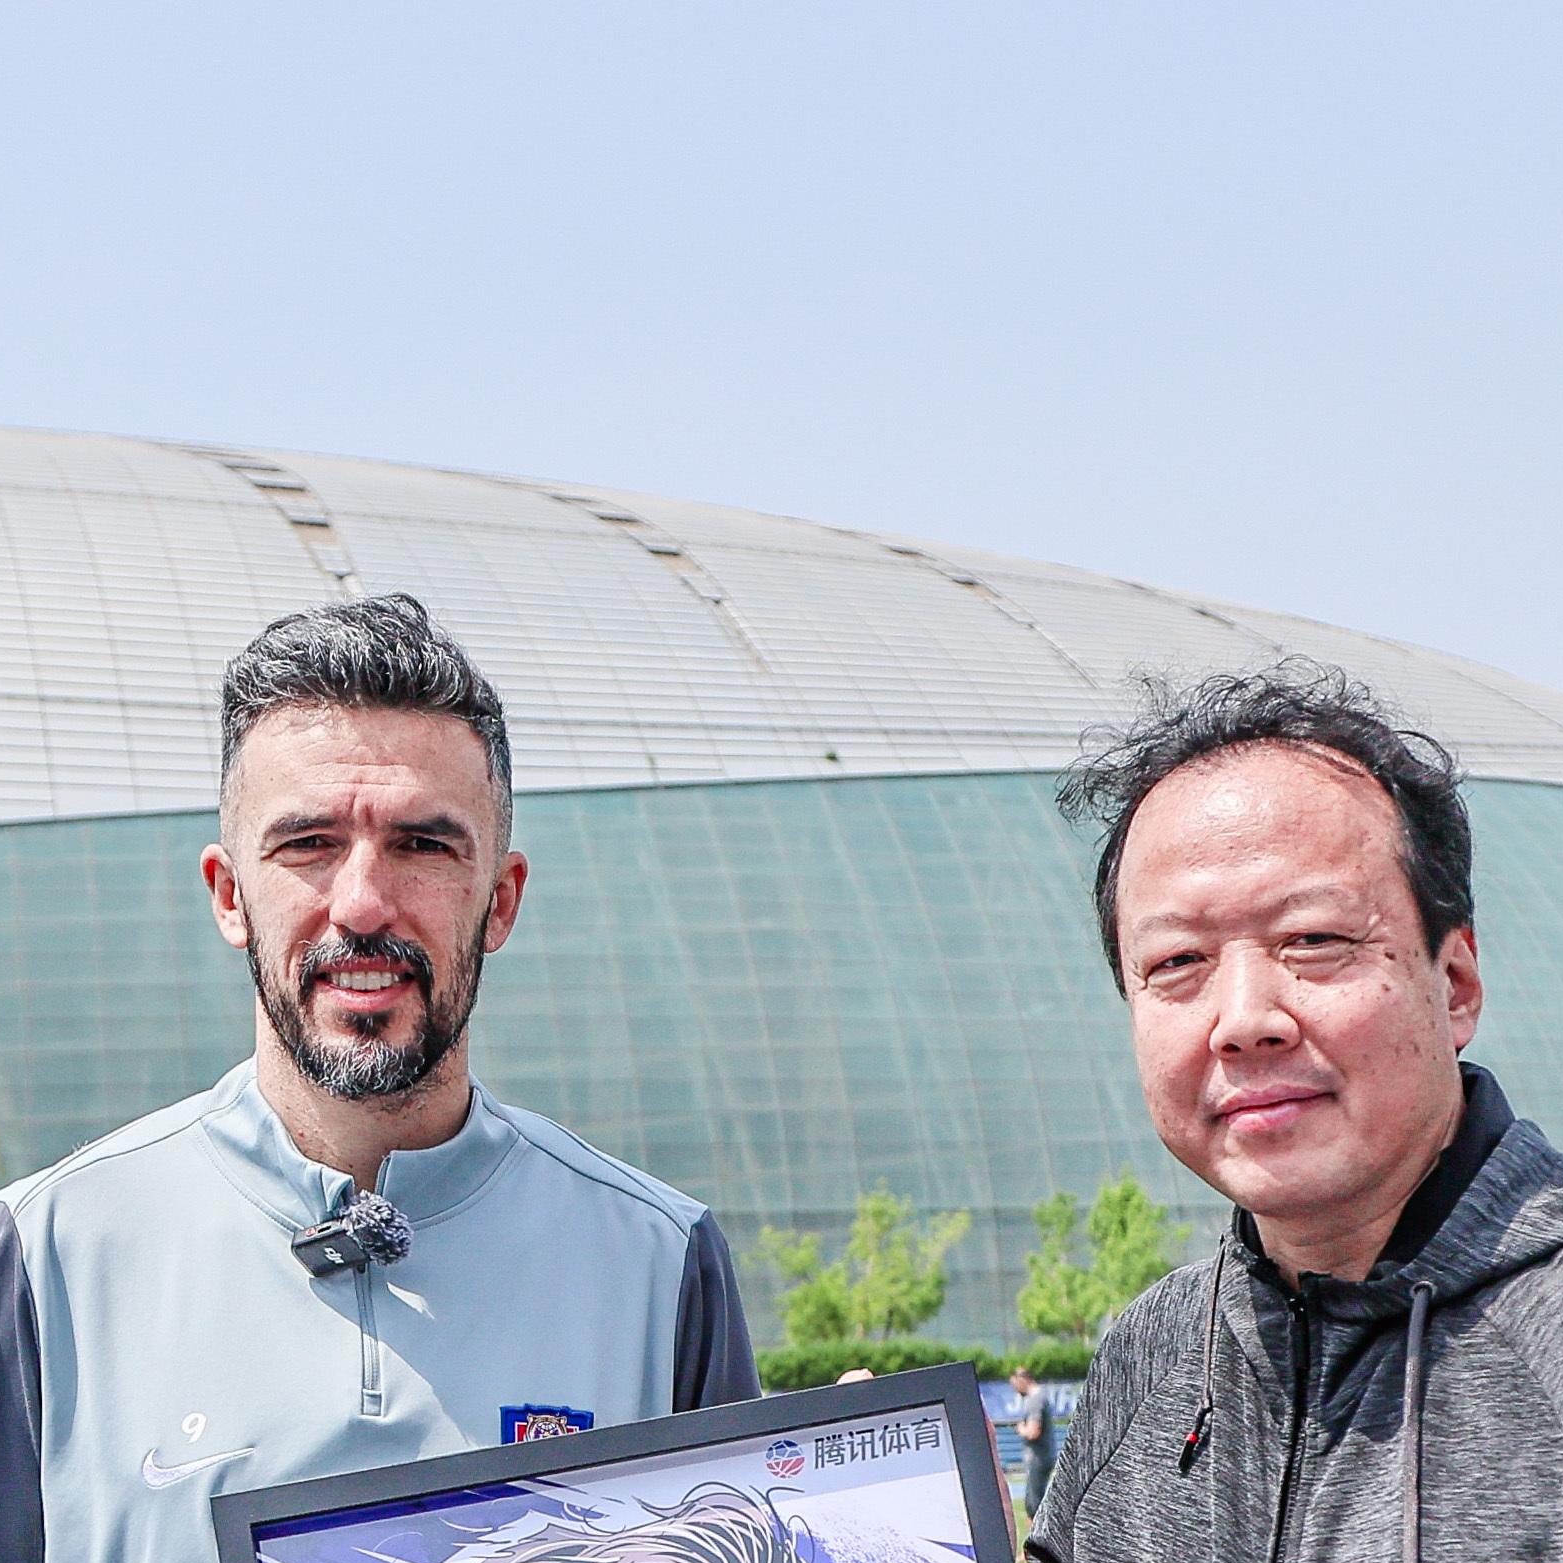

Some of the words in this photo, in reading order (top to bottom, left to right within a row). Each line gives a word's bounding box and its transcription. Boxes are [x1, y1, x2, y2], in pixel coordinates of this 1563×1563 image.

[181, 1411, 207, 1443] 9
[813, 1417, 942, 1470] 腾讯体育
